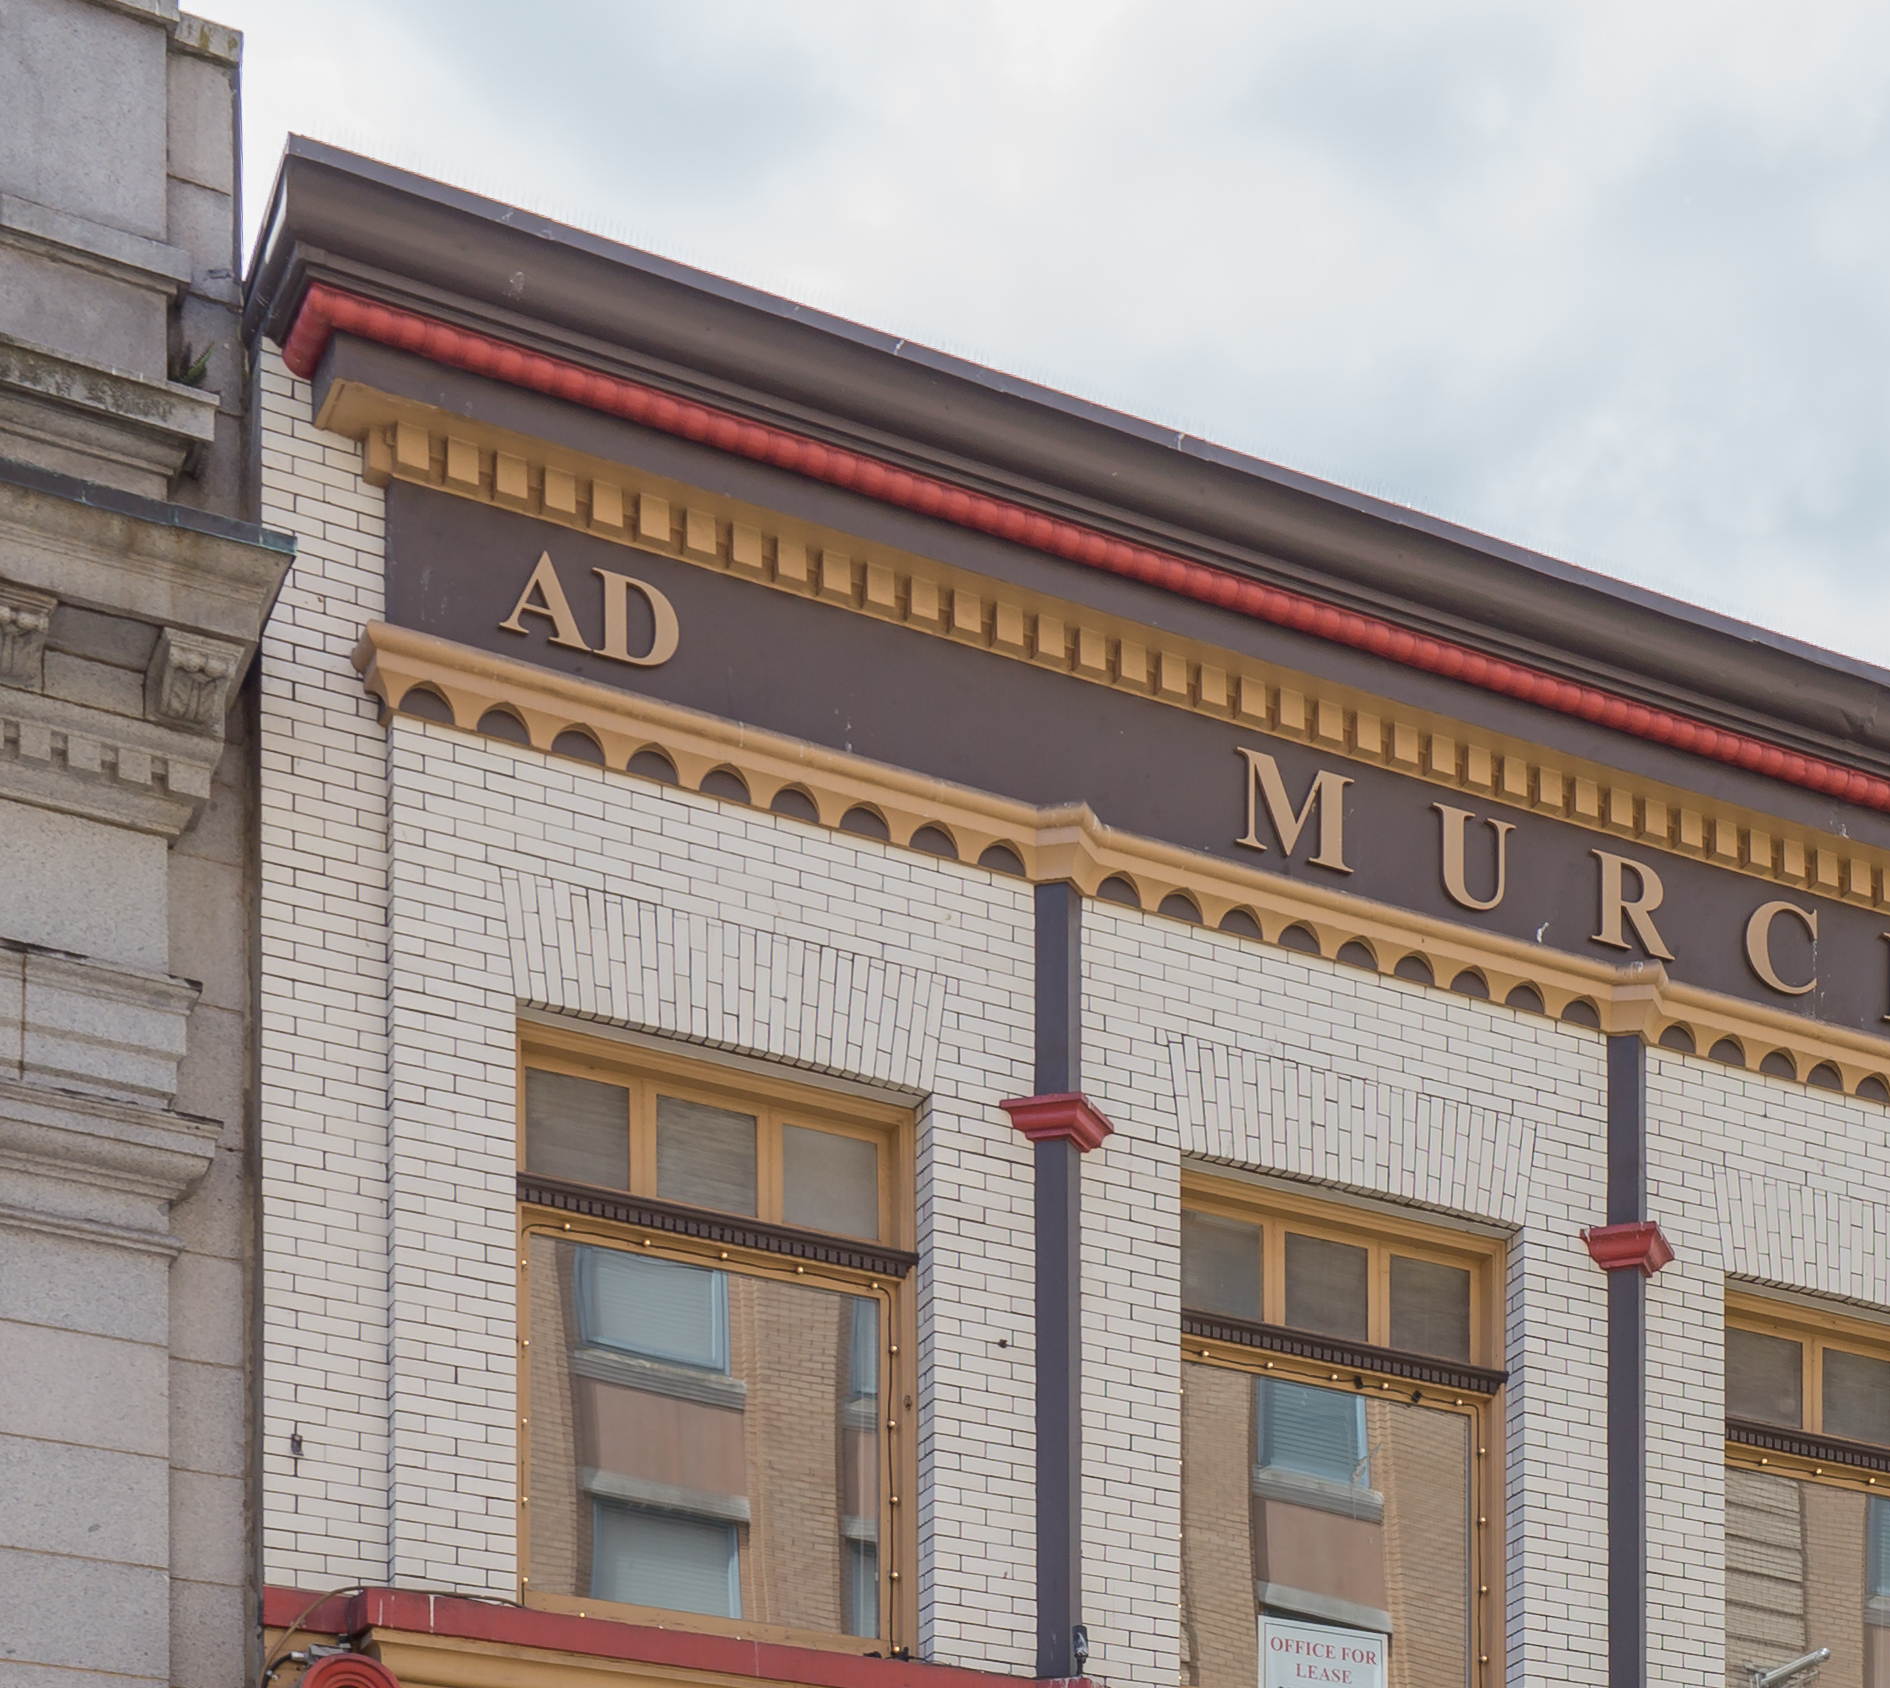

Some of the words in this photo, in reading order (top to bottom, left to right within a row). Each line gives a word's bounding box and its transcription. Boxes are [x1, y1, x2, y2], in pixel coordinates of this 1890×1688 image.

[497, 550, 681, 667] AD
[1270, 1636, 1336, 1660] OFFICE
[1341, 1646, 1378, 1666] FOR
[1296, 1663, 1353, 1685] LEASE
